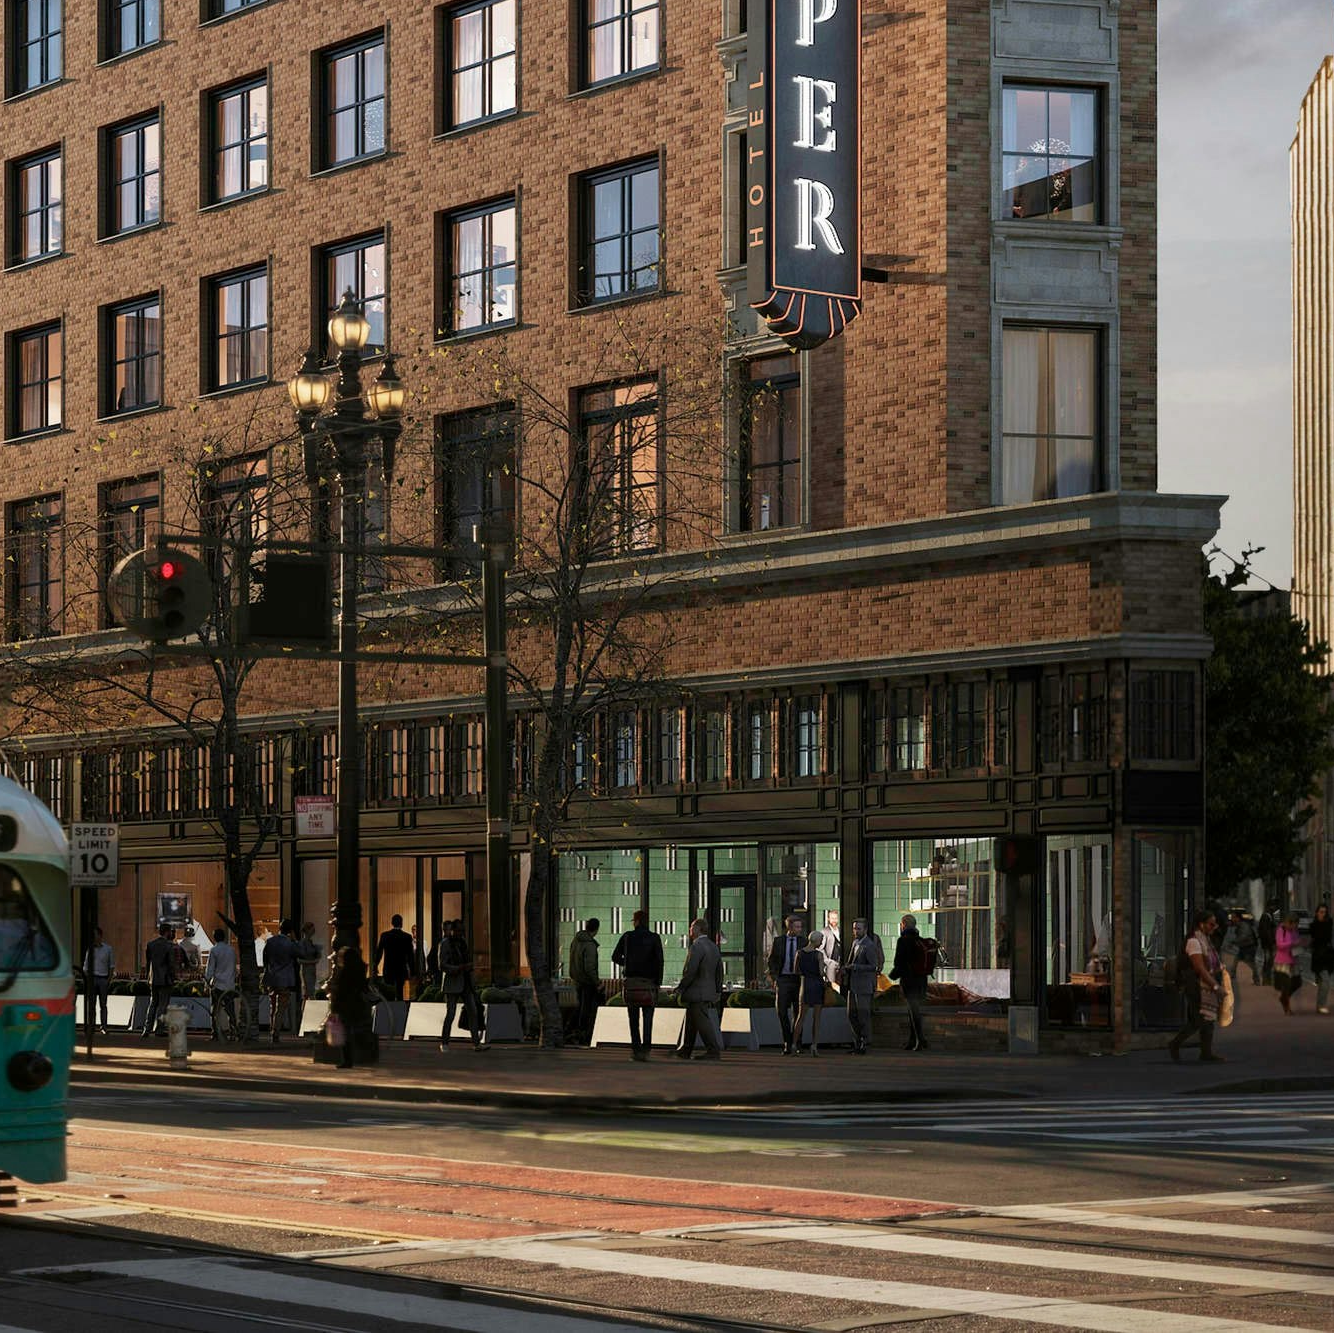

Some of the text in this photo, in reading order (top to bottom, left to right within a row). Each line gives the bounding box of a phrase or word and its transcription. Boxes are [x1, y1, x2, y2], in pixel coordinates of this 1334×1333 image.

[749, 71, 764, 247] HOTEL
[297, 803, 333, 812] NO STOPPING
[308, 813, 324, 821] ANY
[75, 827, 116, 836] SPEED
[78, 840, 111, 850] LIMIT
[81, 853, 109, 874] 10
